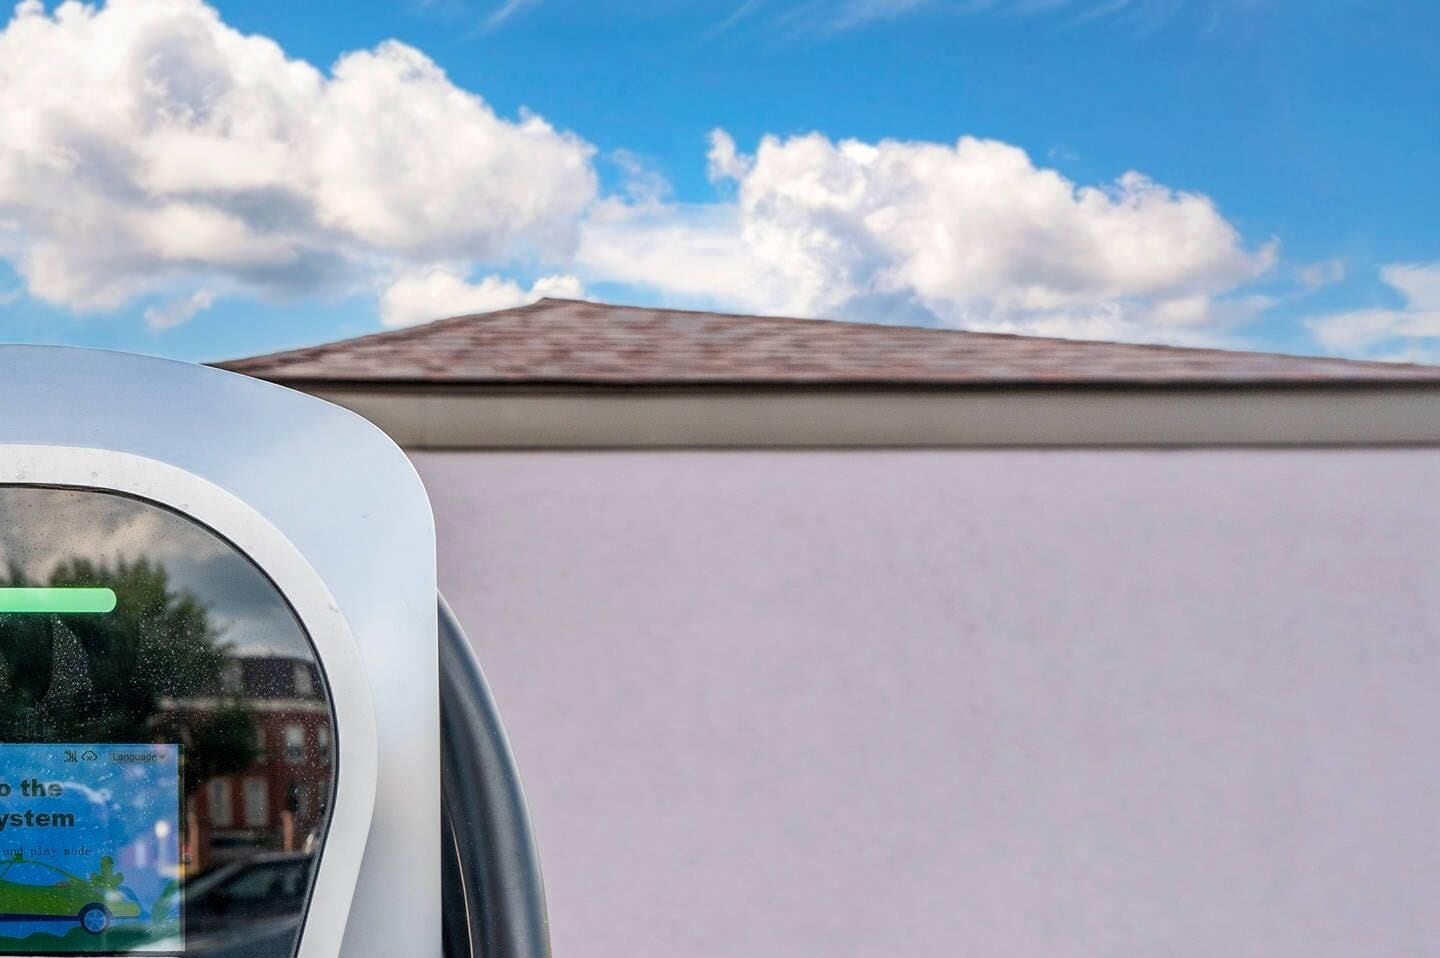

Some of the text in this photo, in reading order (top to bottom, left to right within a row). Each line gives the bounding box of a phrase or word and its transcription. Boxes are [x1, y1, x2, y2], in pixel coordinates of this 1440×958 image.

[112, 752, 157, 764] Language
[20, 778, 63, 797] the
[4, 846, 24, 857] and
[30, 846, 57, 857] play
[63, 846, 91, 857] mode
